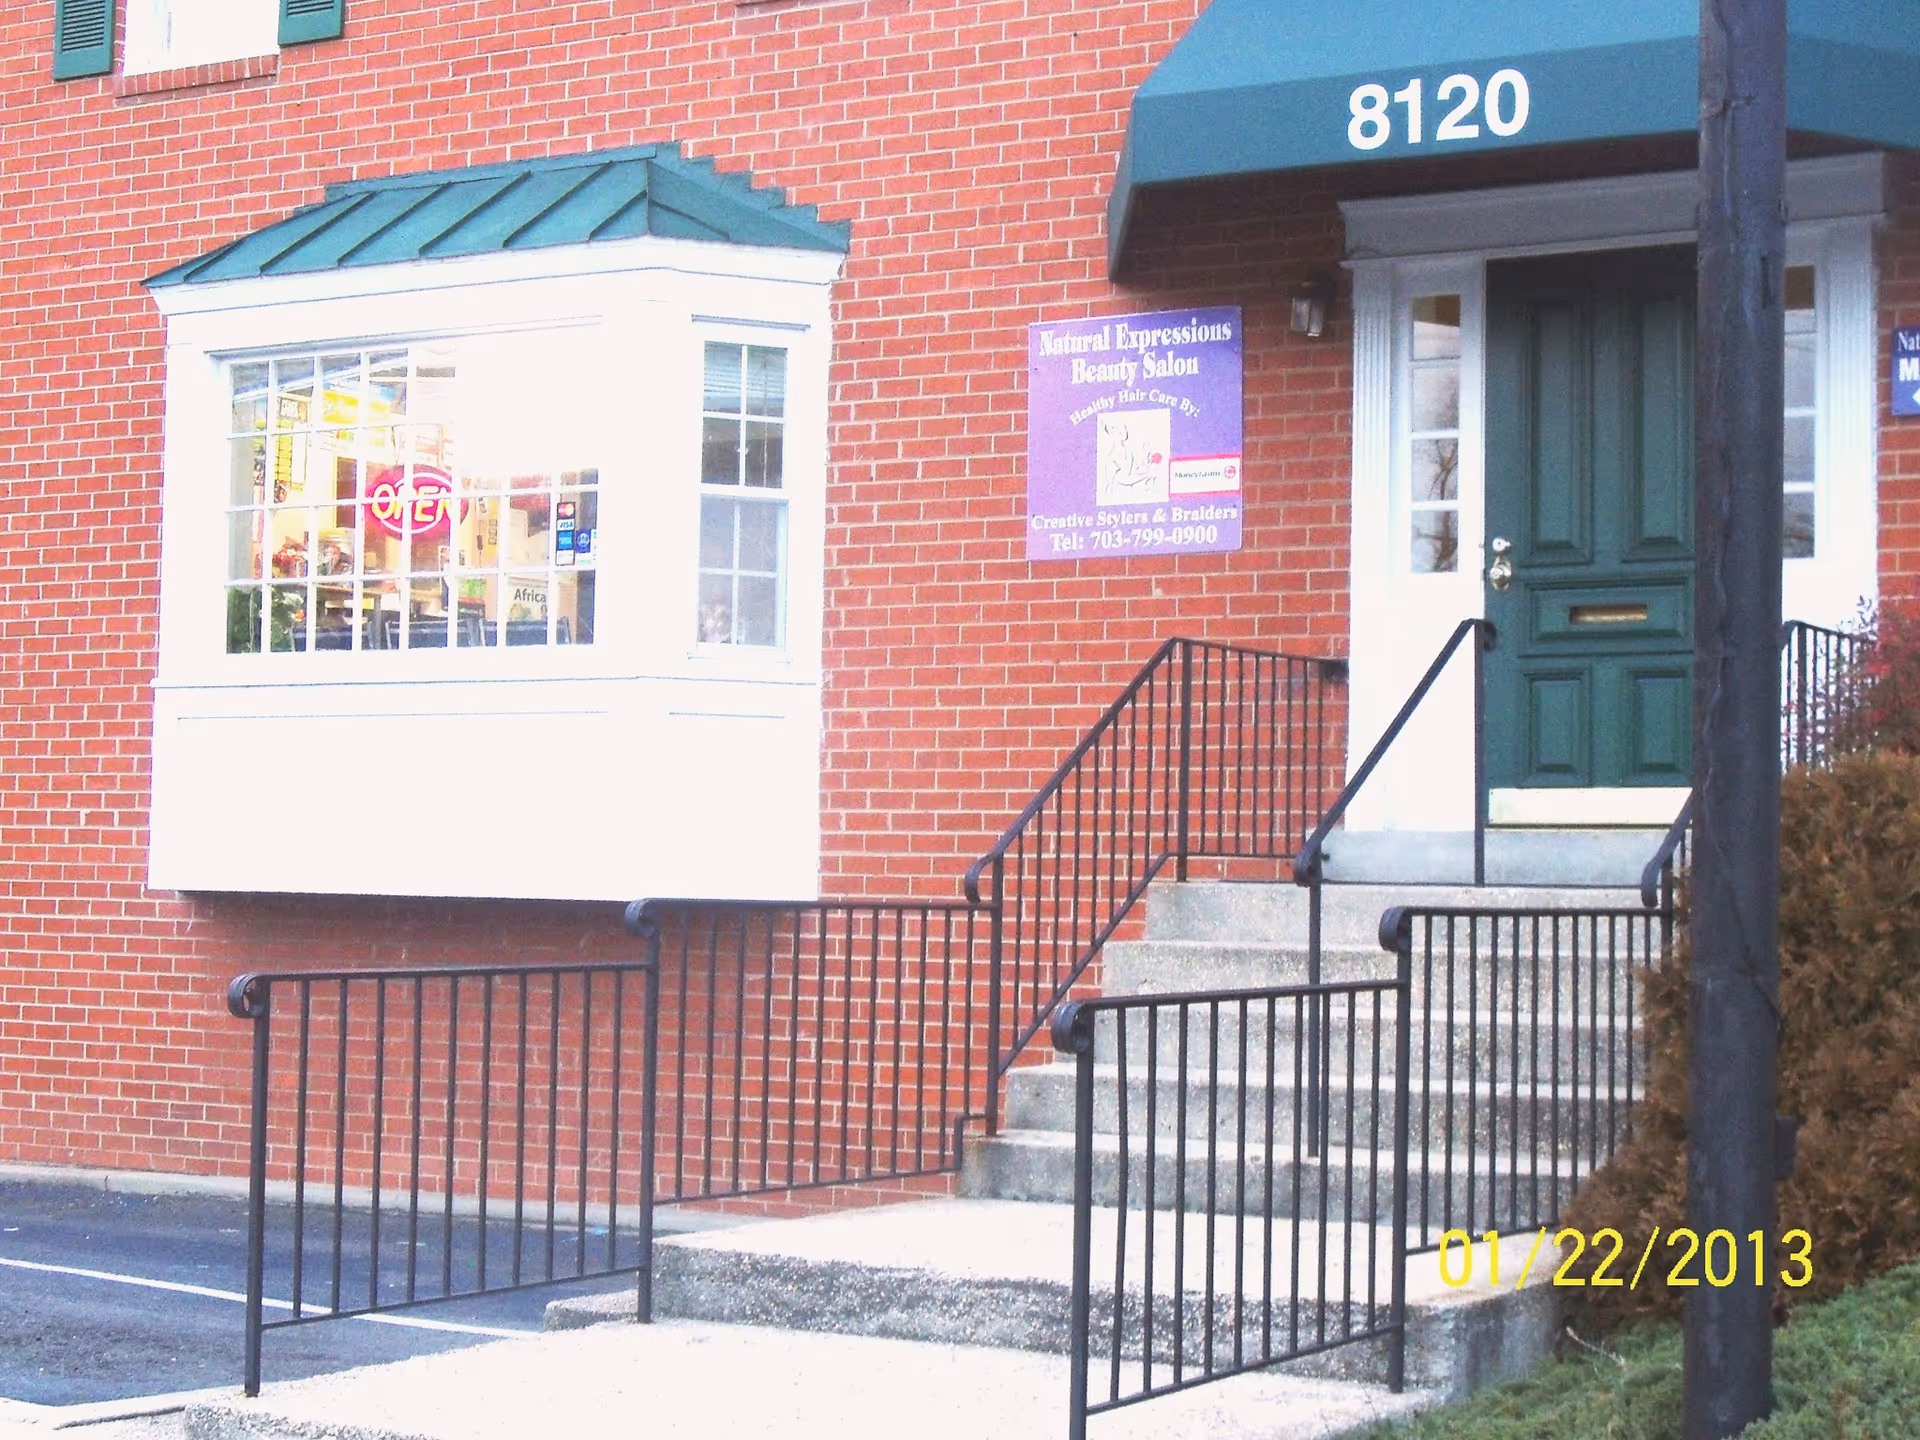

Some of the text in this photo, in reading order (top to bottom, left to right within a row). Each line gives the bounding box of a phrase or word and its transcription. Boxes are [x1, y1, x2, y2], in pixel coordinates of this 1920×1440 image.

[1347, 68, 1530, 150] 8120
[1039, 317, 1233, 357] Natural Expressions
[1071, 350, 1200, 387] Beauty Salon
[1069, 388, 1200, 426] Healthy Hair Care By:
[1031, 505, 1238, 530] Creative Stylers & Braiders
[1050, 525, 1218, 552] Tel: 703-799-0900
